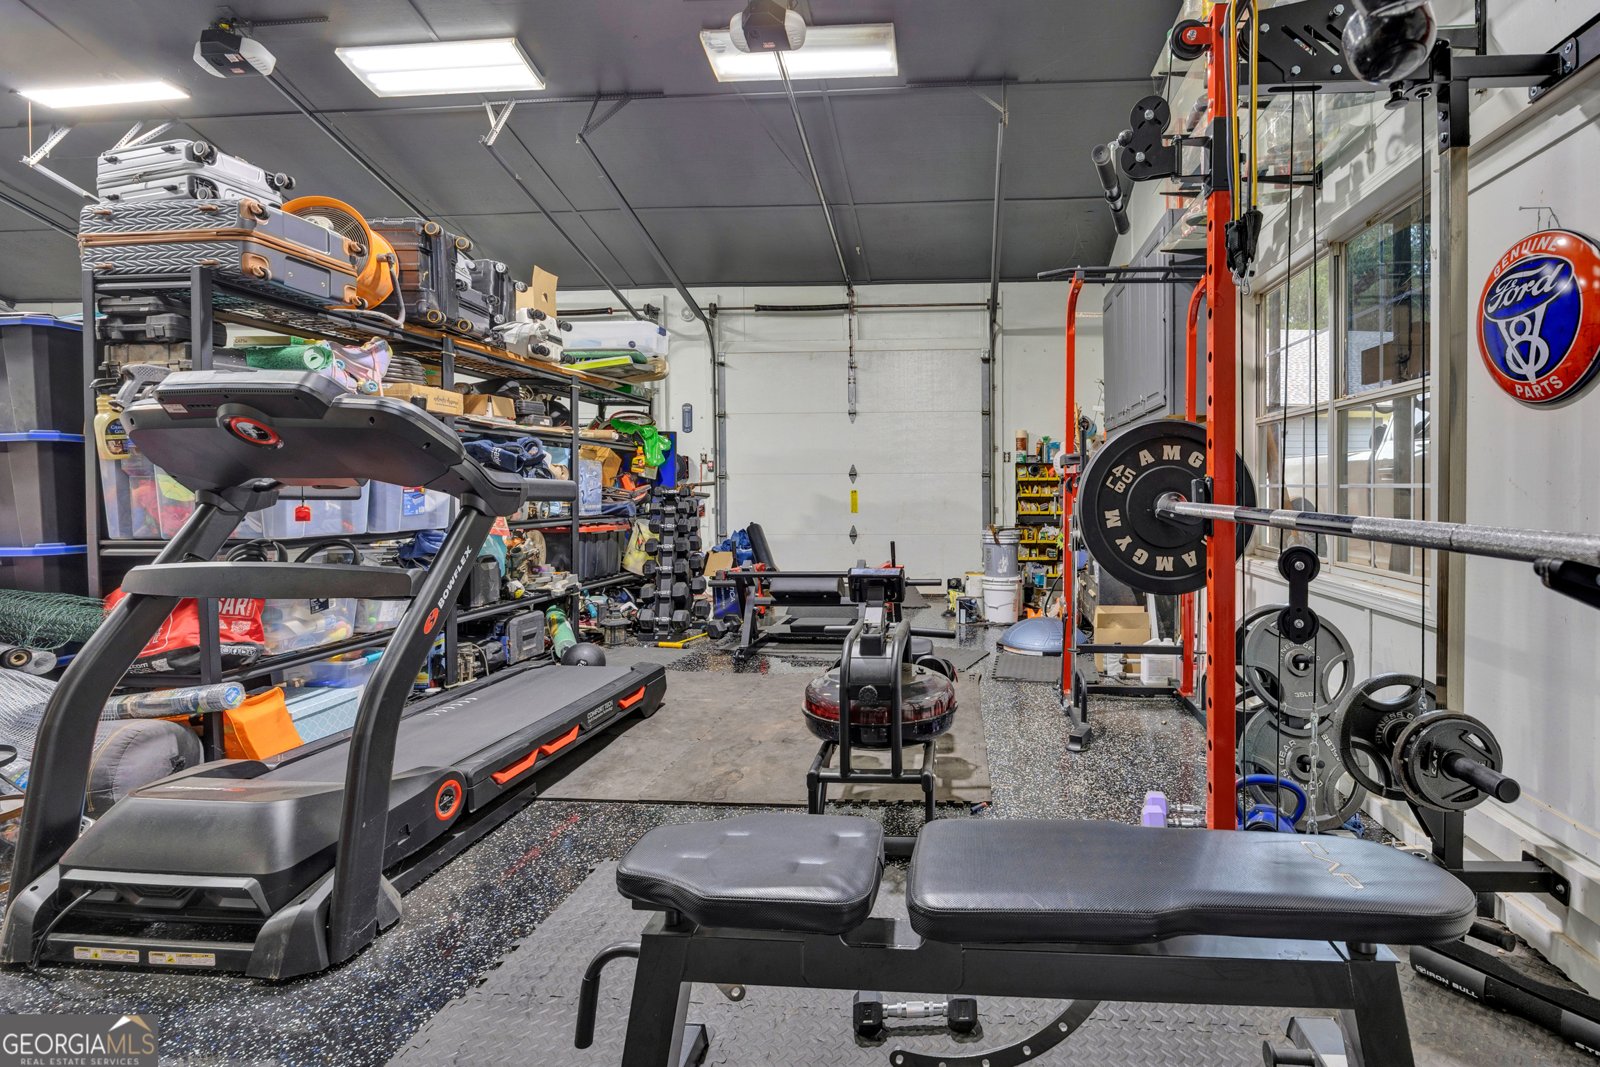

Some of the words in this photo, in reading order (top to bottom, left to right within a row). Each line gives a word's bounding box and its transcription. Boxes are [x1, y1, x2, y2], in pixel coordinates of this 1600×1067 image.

[1494, 236, 1559, 277] GENUINE
[1487, 263, 1565, 313] Ford
[1497, 304, 1549, 385] V8
[1515, 375, 1563, 399] PARTS
[1138, 444, 1206, 470] AMG
[1106, 476, 1127, 494] LB
[1111, 464, 1137, 485] 45
[437, 545, 473, 609] BOWFLEX
[1302, 642, 1321, 661] GER
[1278, 739, 1297, 766] GEAR
[1426, 970, 1449, 985] IRON
[1451, 982, 1479, 999] BULL
